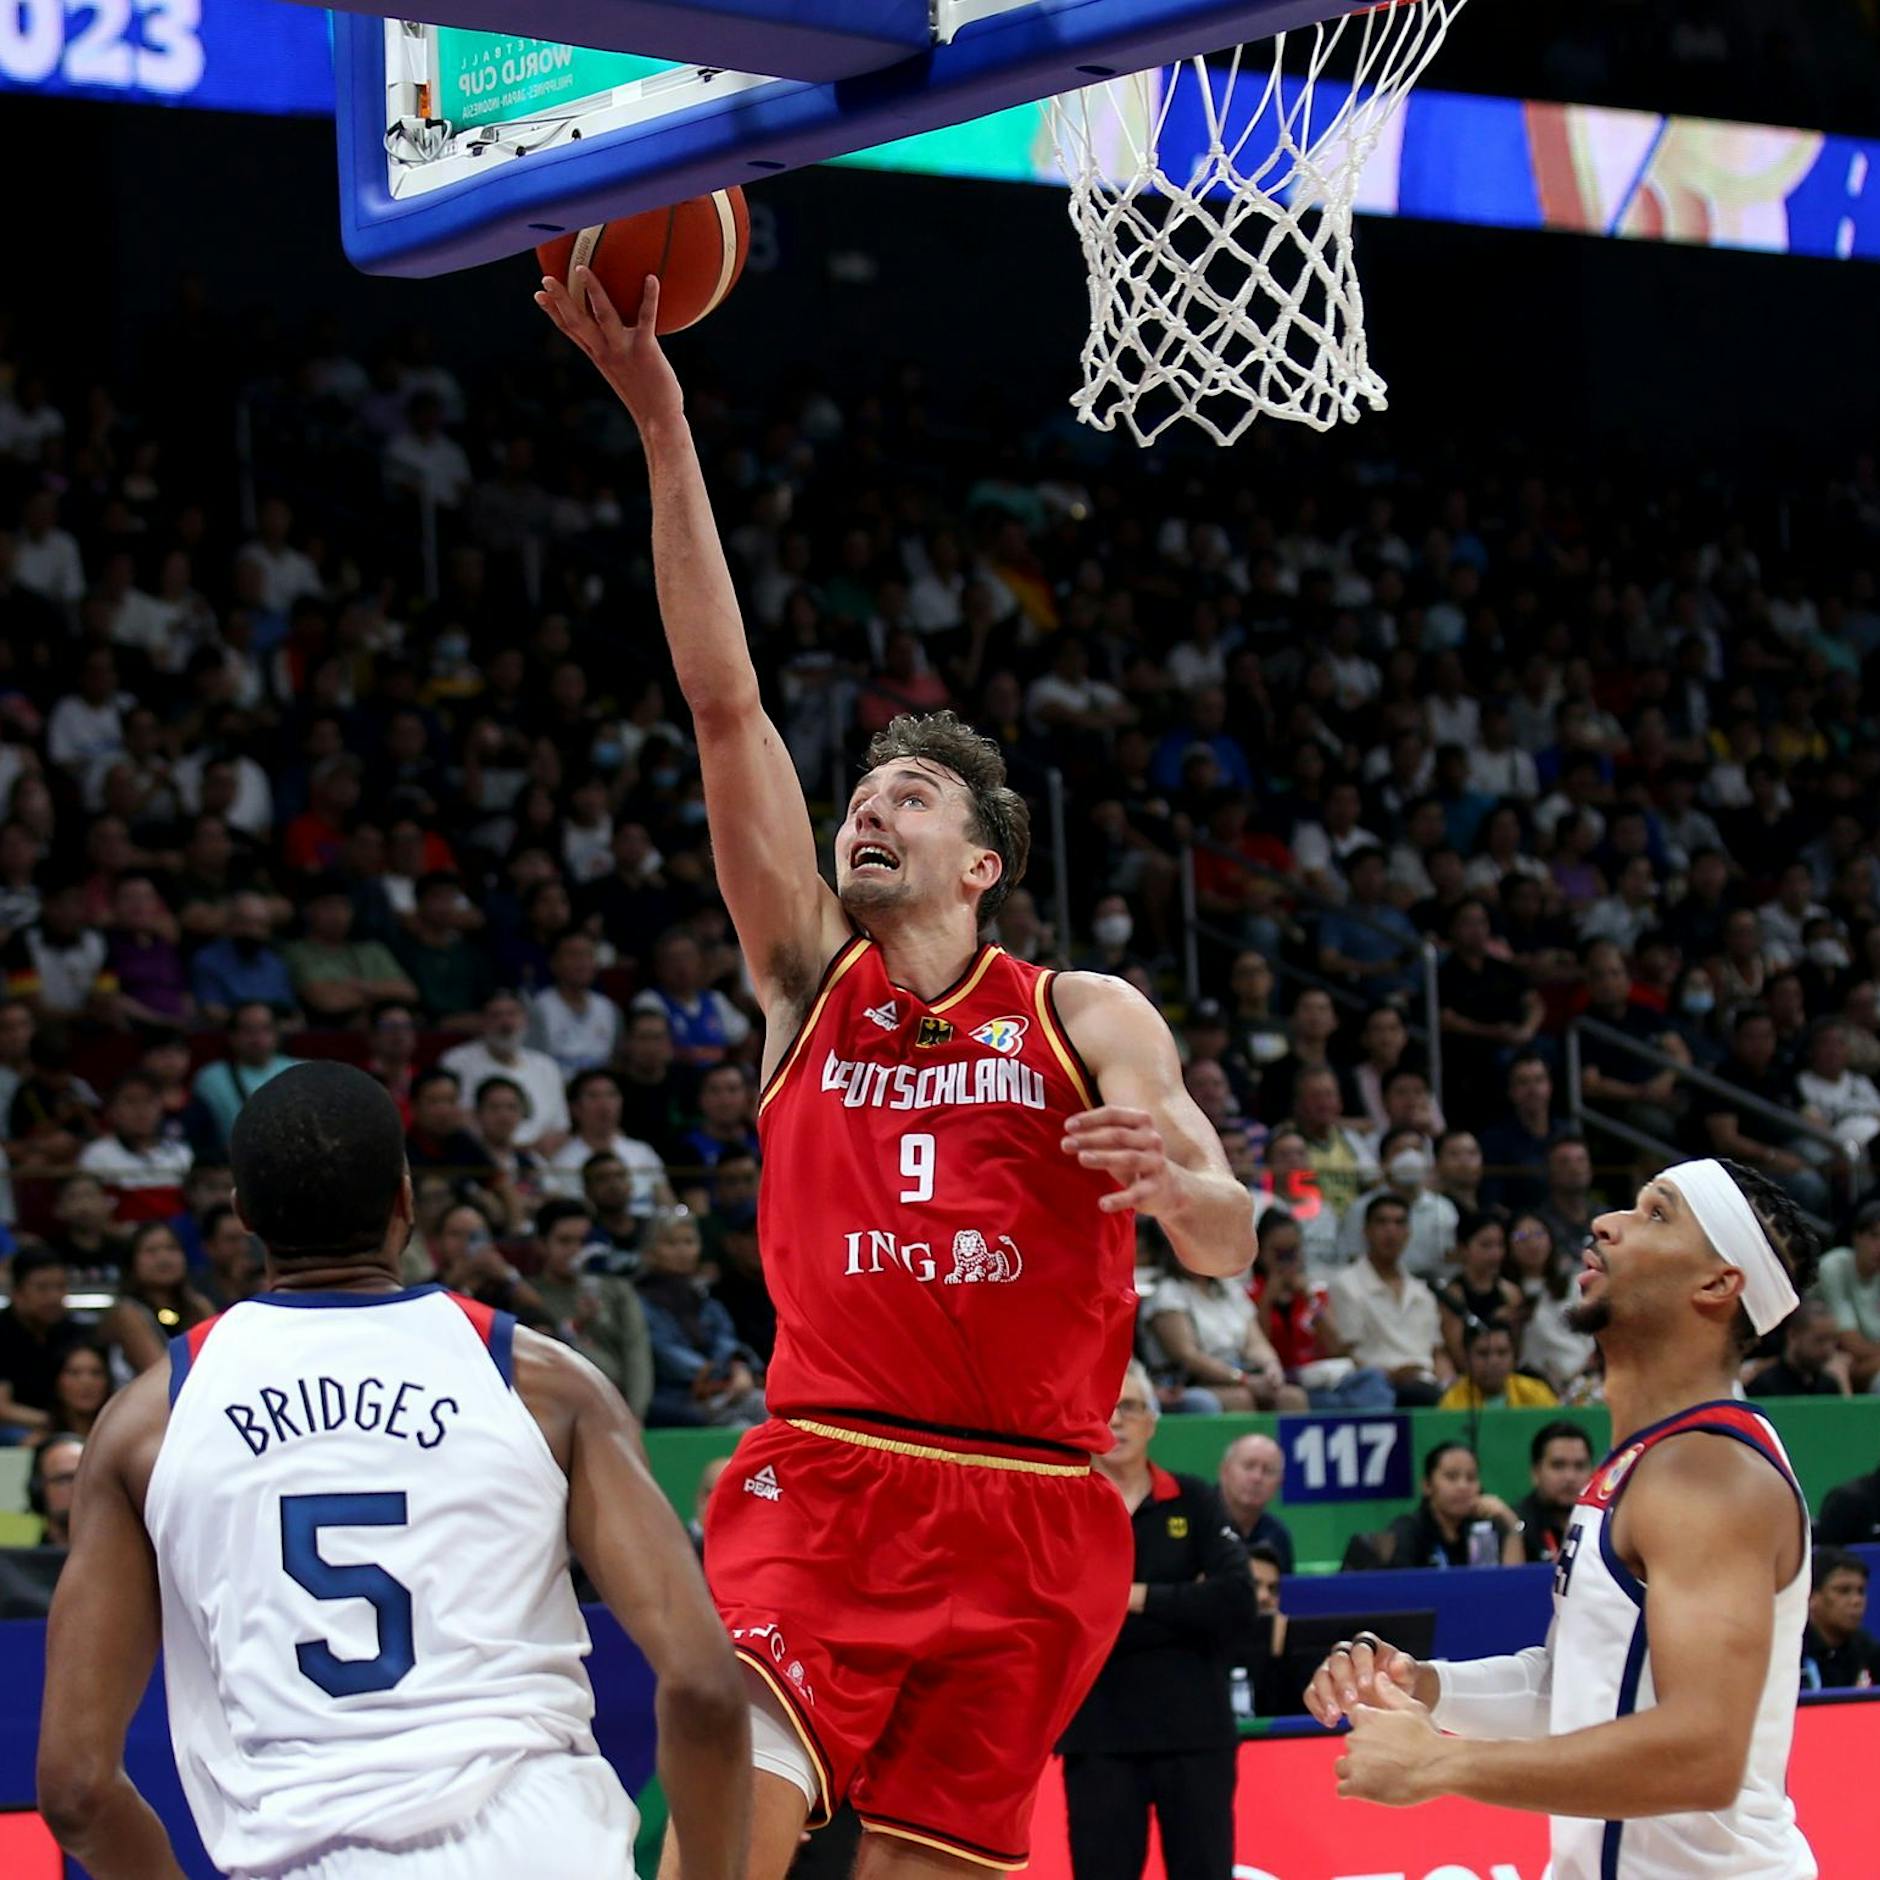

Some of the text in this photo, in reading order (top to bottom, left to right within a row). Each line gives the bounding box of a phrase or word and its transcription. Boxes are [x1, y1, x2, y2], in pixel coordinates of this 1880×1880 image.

[900, 1133, 935, 1203] 9
[843, 1230, 936, 1282] ING
[224, 1377, 459, 1456] BRIDGES
[1293, 1422, 1398, 1489] 117
[743, 1478, 783, 1502] PEAK
[279, 1491, 416, 1698] 5
